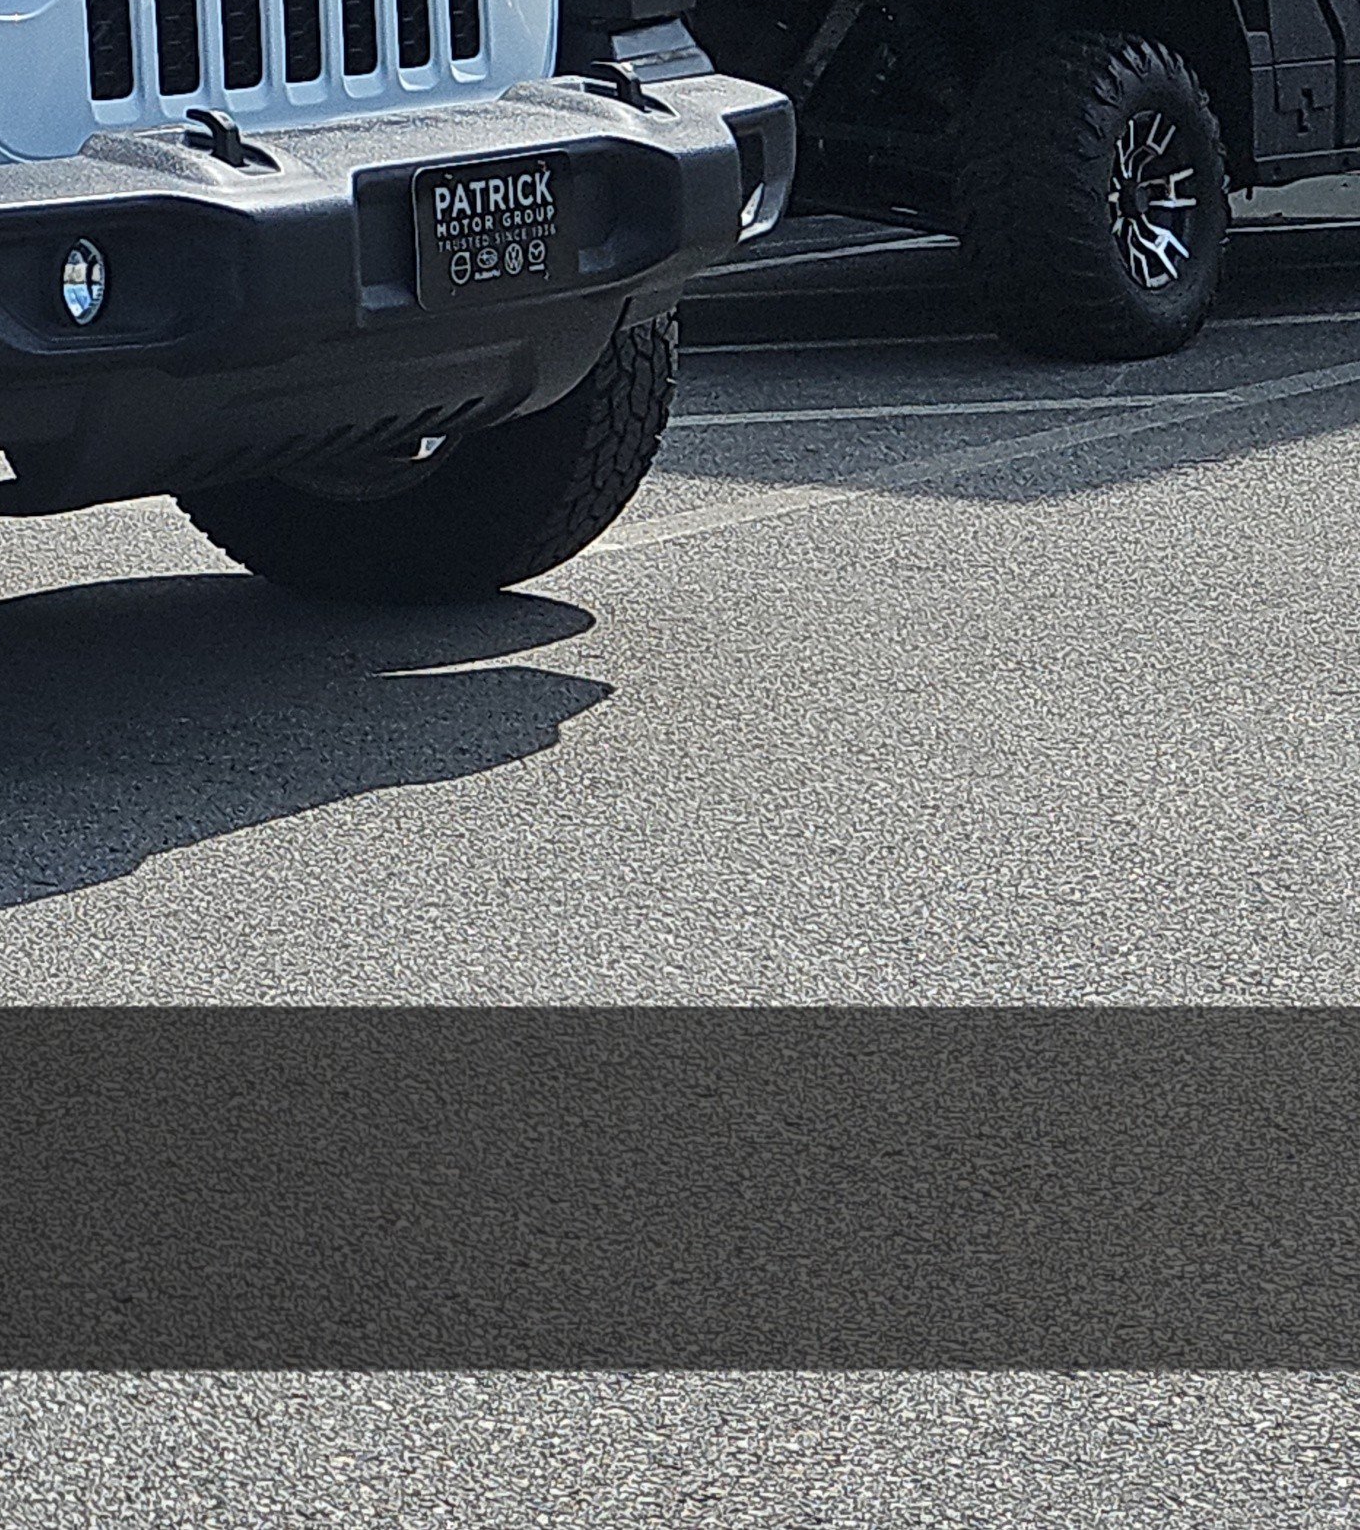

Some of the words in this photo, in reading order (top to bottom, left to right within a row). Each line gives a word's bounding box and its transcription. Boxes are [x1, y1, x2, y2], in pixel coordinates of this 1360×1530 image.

[434, 169, 554, 221] PATRICK
[436, 214, 494, 238] MOTOR
[501, 204, 555, 227] GROUP
[438, 234, 490, 252] TRUSTED
[494, 227, 527, 244] SINCE
